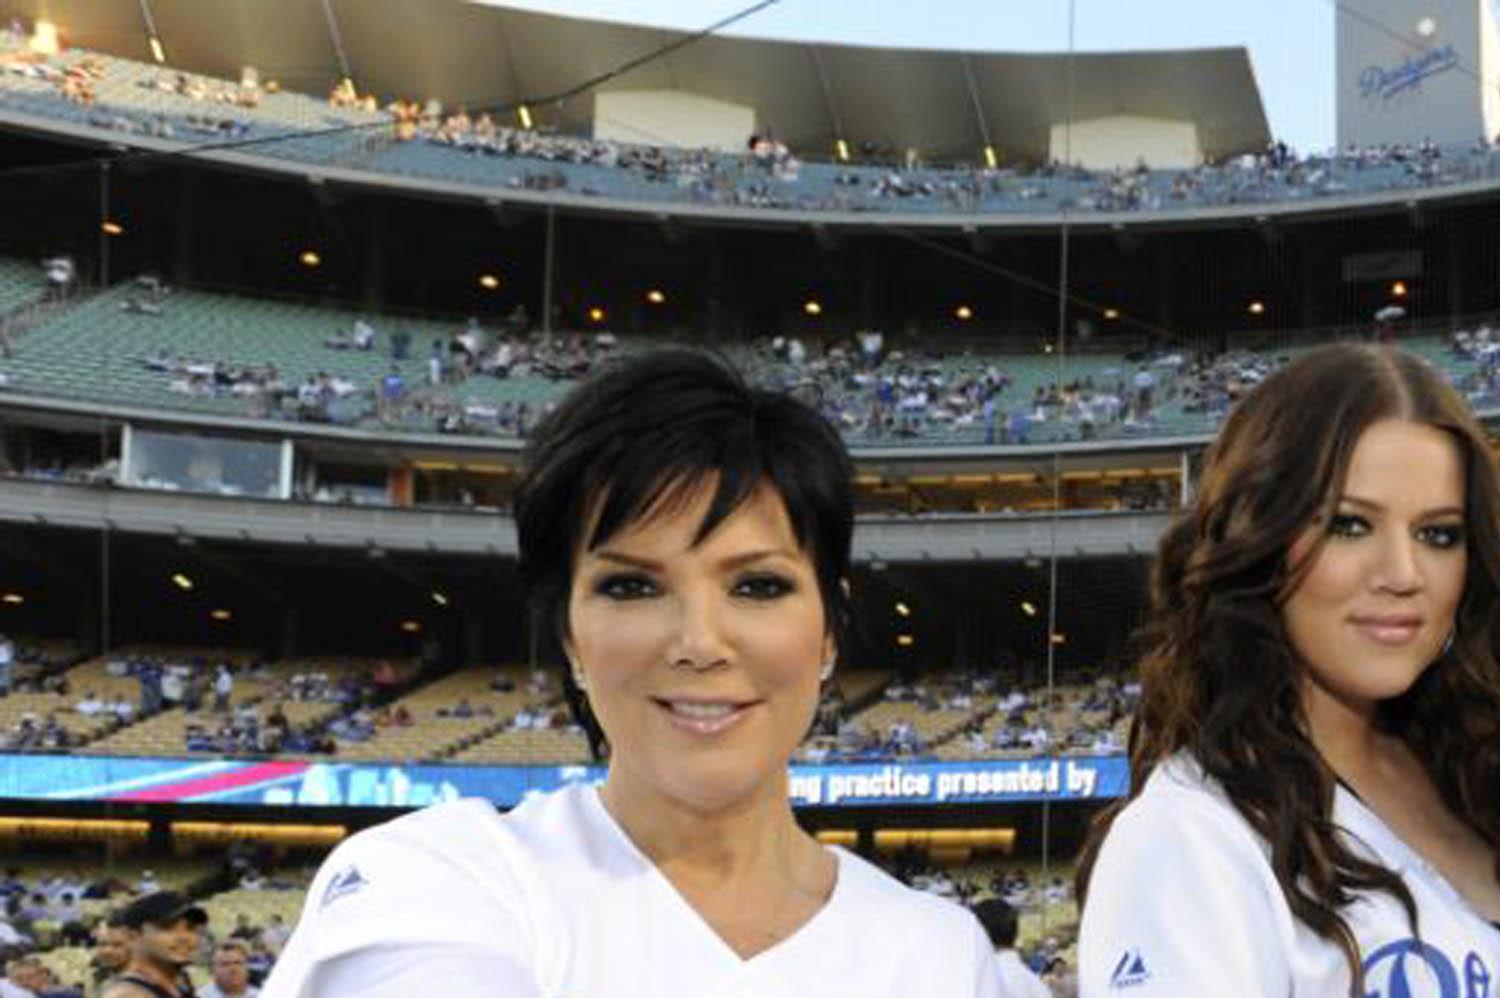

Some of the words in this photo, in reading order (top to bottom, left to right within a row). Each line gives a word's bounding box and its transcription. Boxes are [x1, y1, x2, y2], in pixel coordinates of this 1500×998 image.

[828, 765, 931, 804] practice
[937, 761, 1059, 800] presented
[1066, 757, 1097, 796] by
